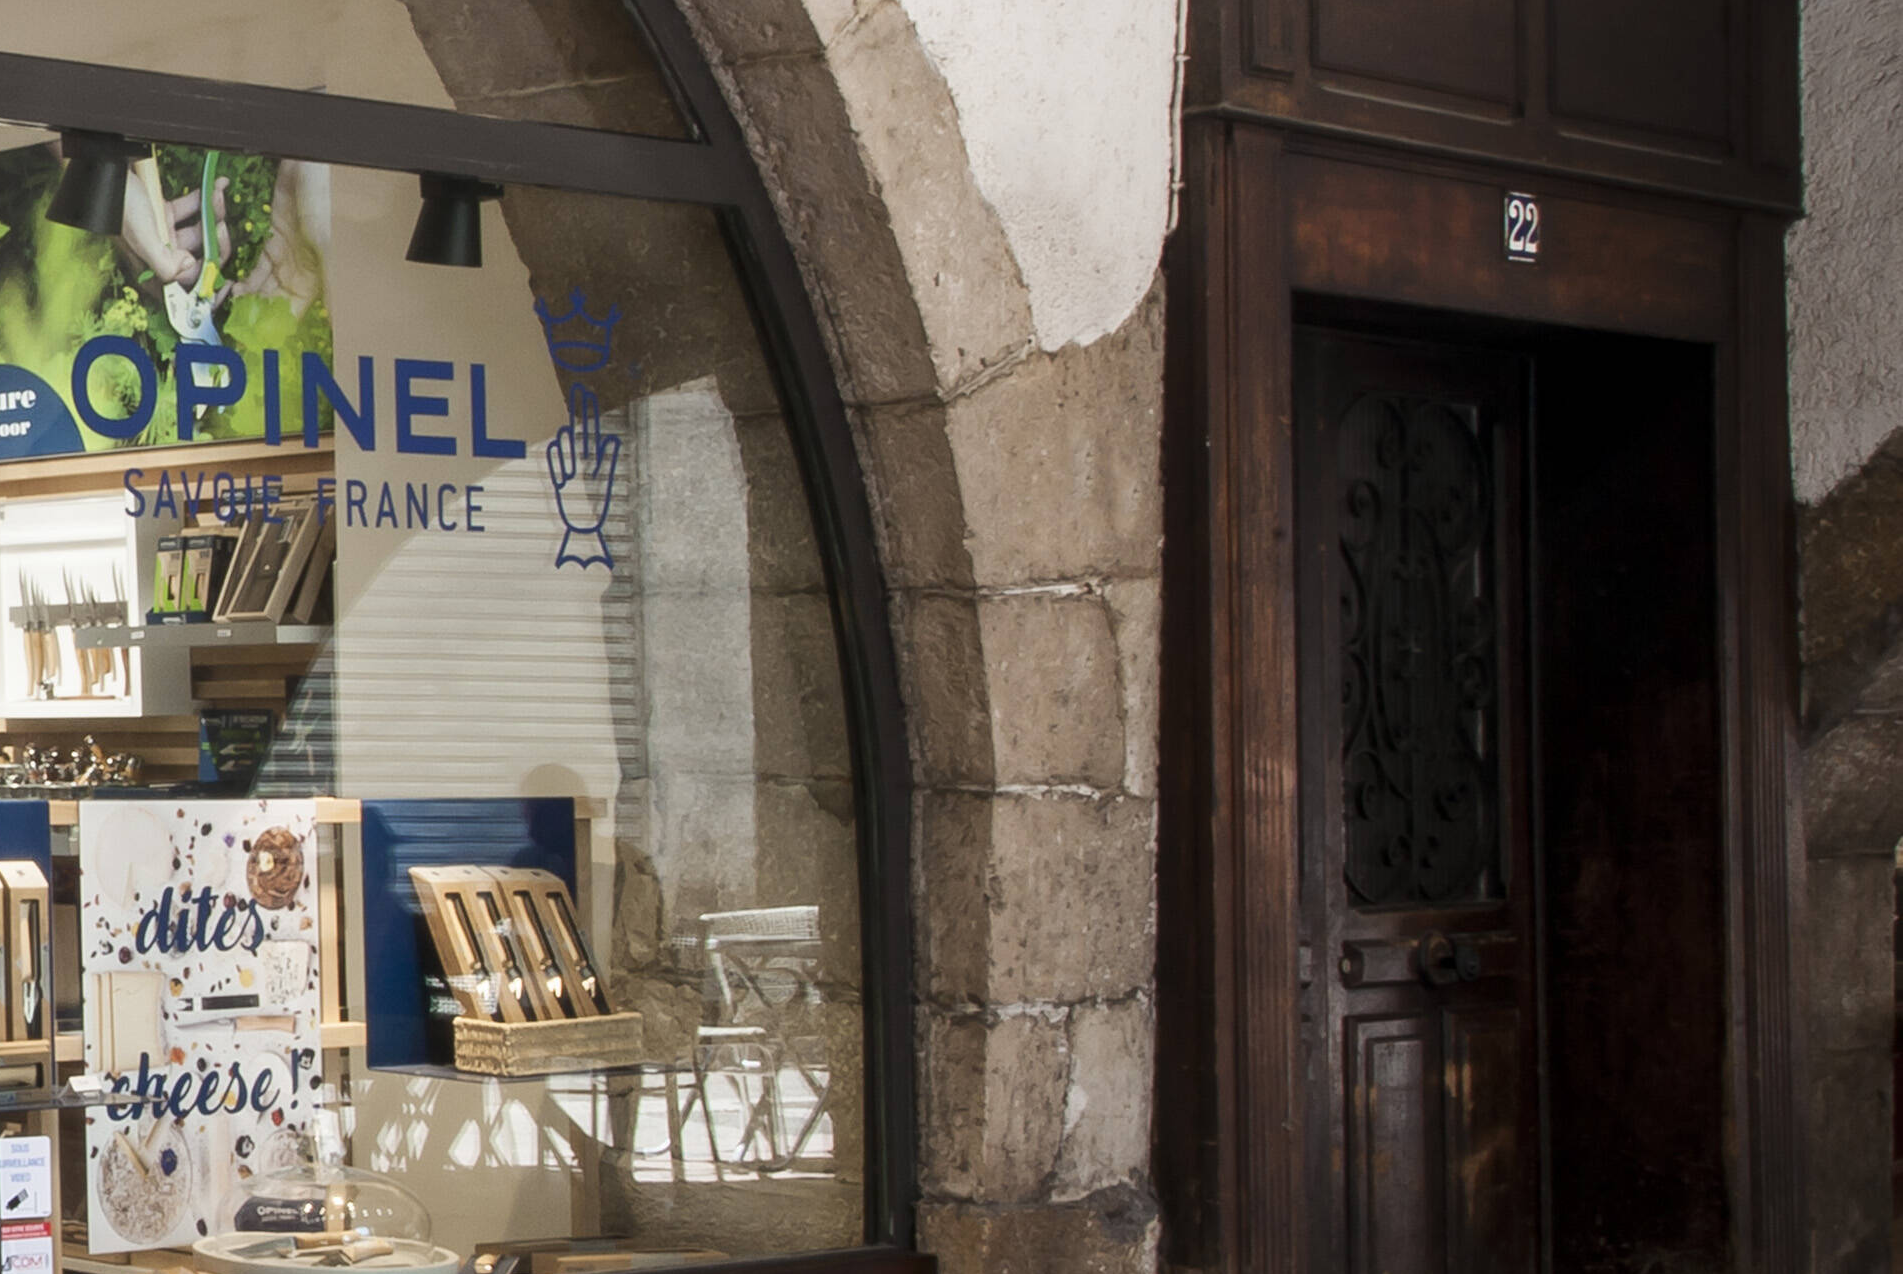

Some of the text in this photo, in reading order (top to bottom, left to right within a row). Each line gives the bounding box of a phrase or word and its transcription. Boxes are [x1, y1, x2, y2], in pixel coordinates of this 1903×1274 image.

[1508, 199, 1538, 253] 22
[71, 335, 527, 459] OPINEL
[124, 467, 486, 532] SAVOIE FRANCE
[135, 886, 265, 954] dites
